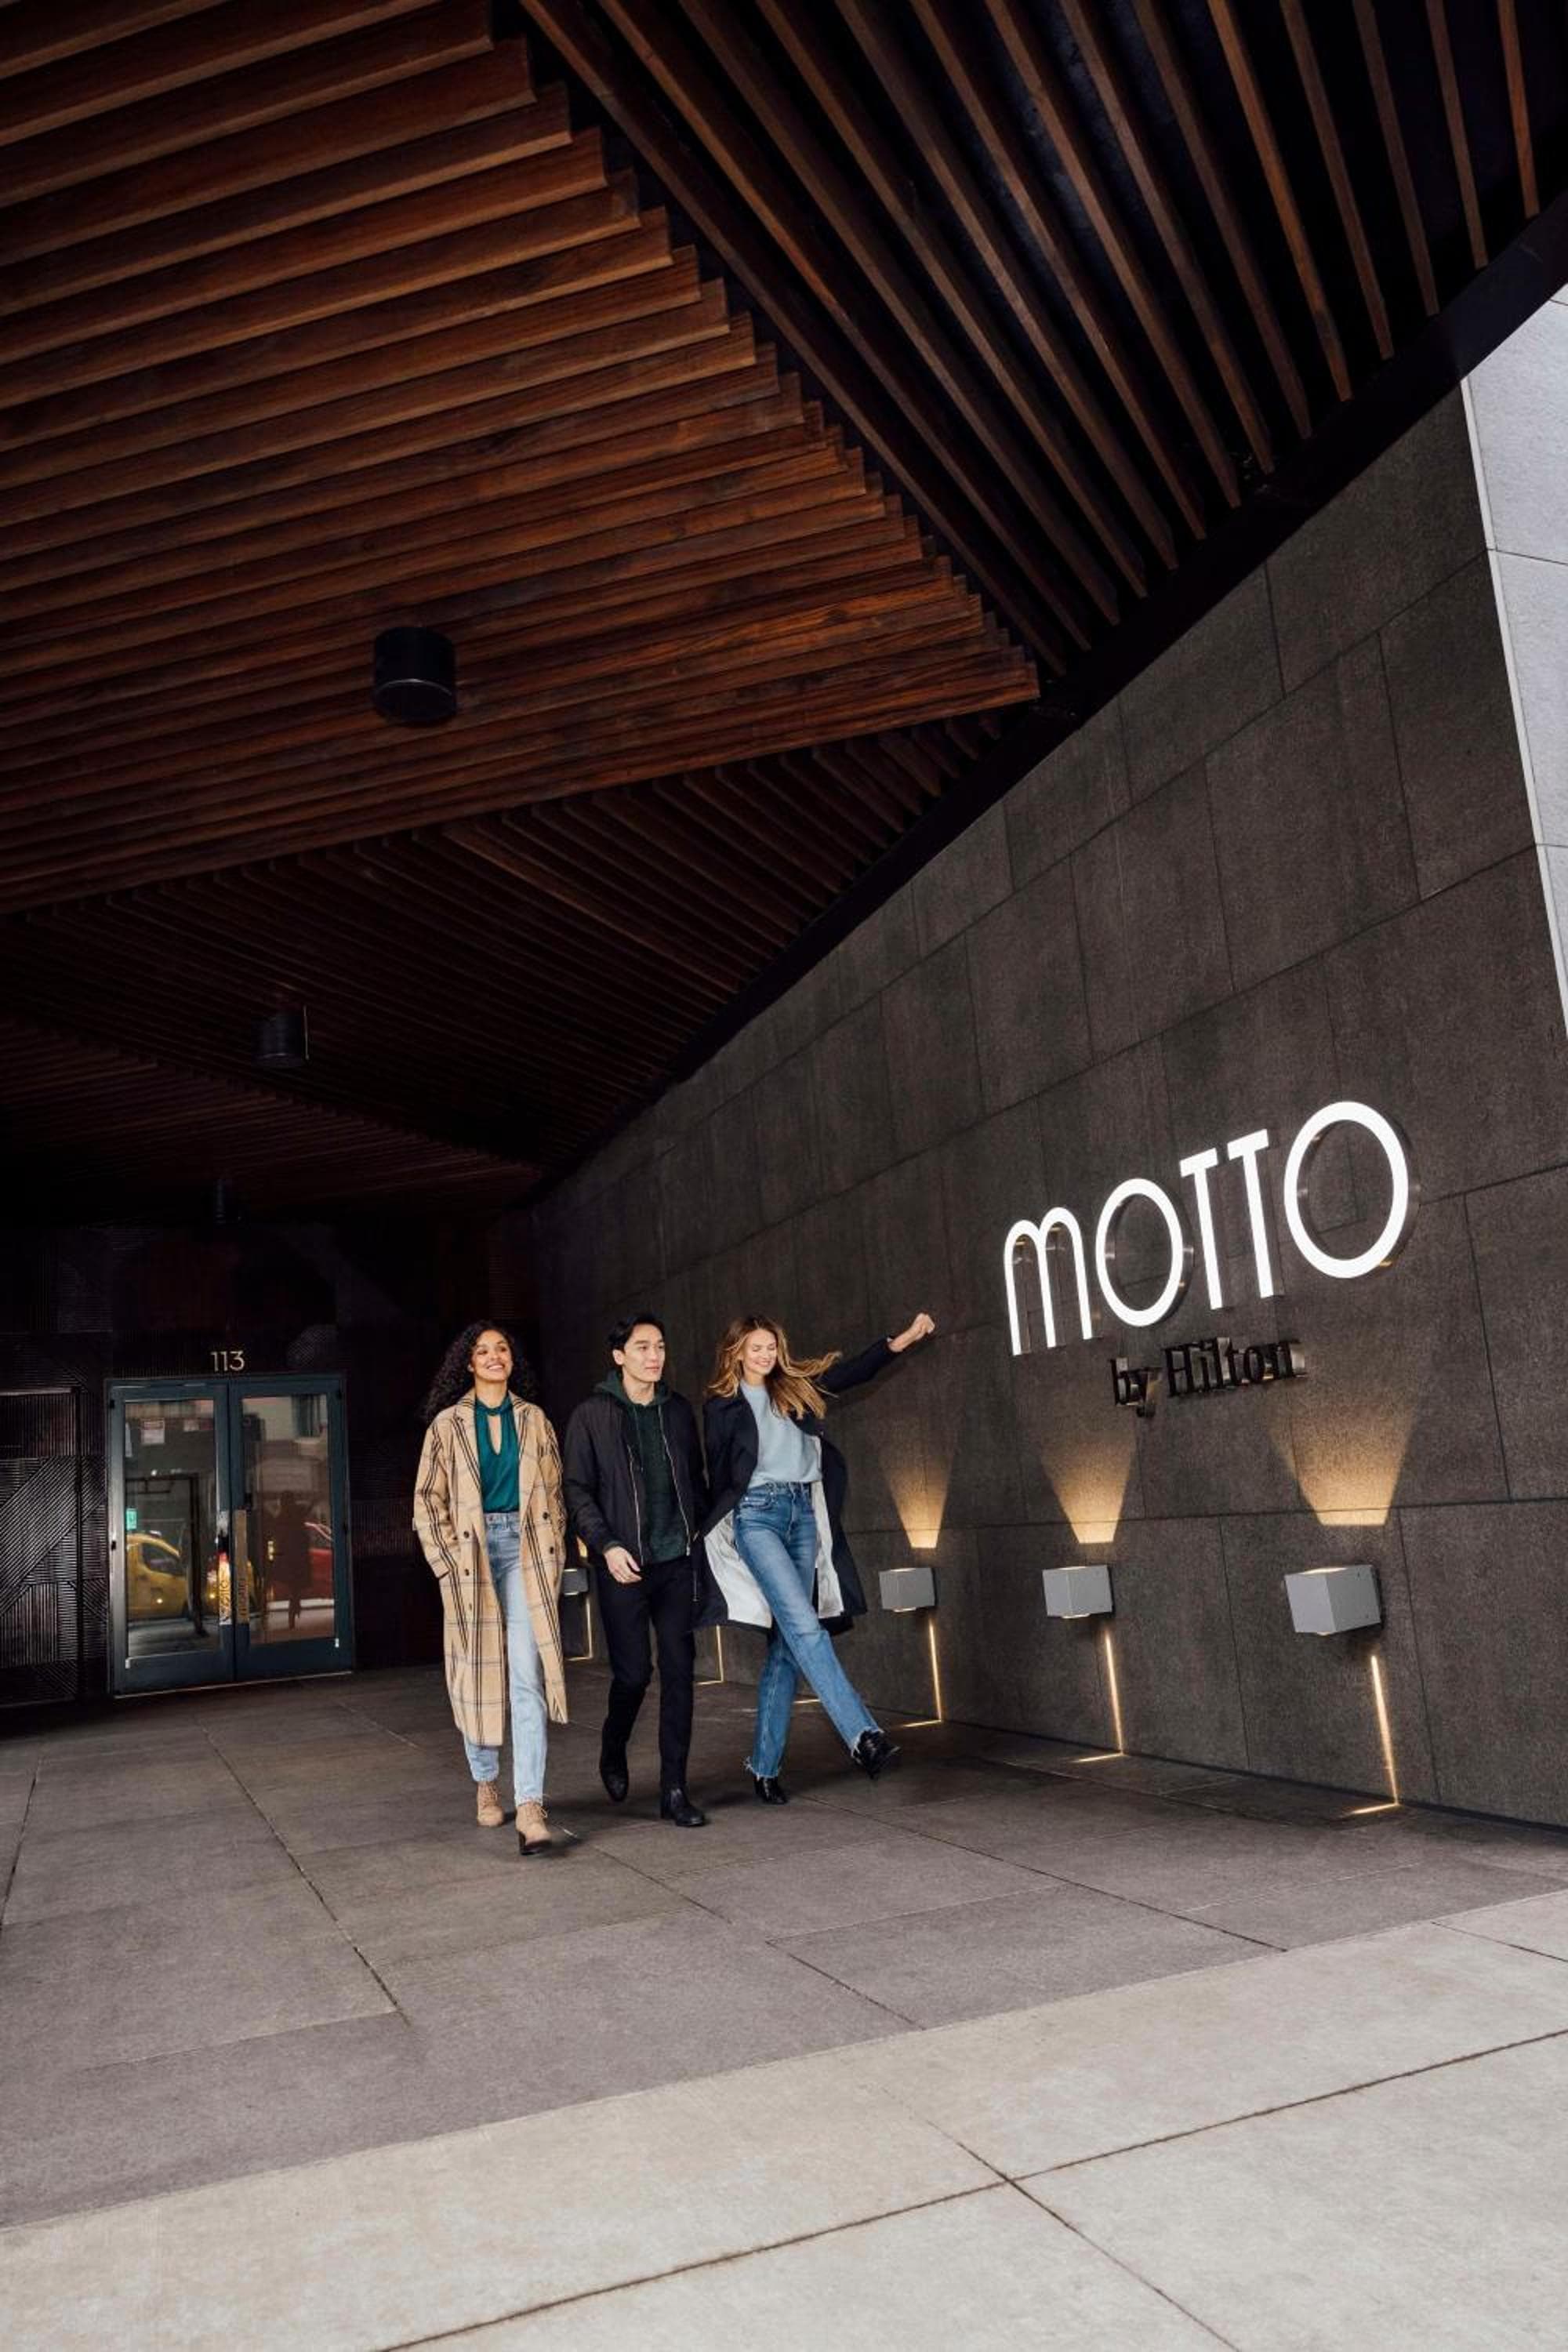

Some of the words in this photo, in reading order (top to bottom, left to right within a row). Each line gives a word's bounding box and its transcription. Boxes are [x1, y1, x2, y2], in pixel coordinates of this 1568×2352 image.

[1004, 1101, 1409, 1356] MOTTO
[210, 1351, 245, 1371] 113
[1110, 1357, 1159, 1417] by
[1163, 1337, 1303, 1396] Hilton
